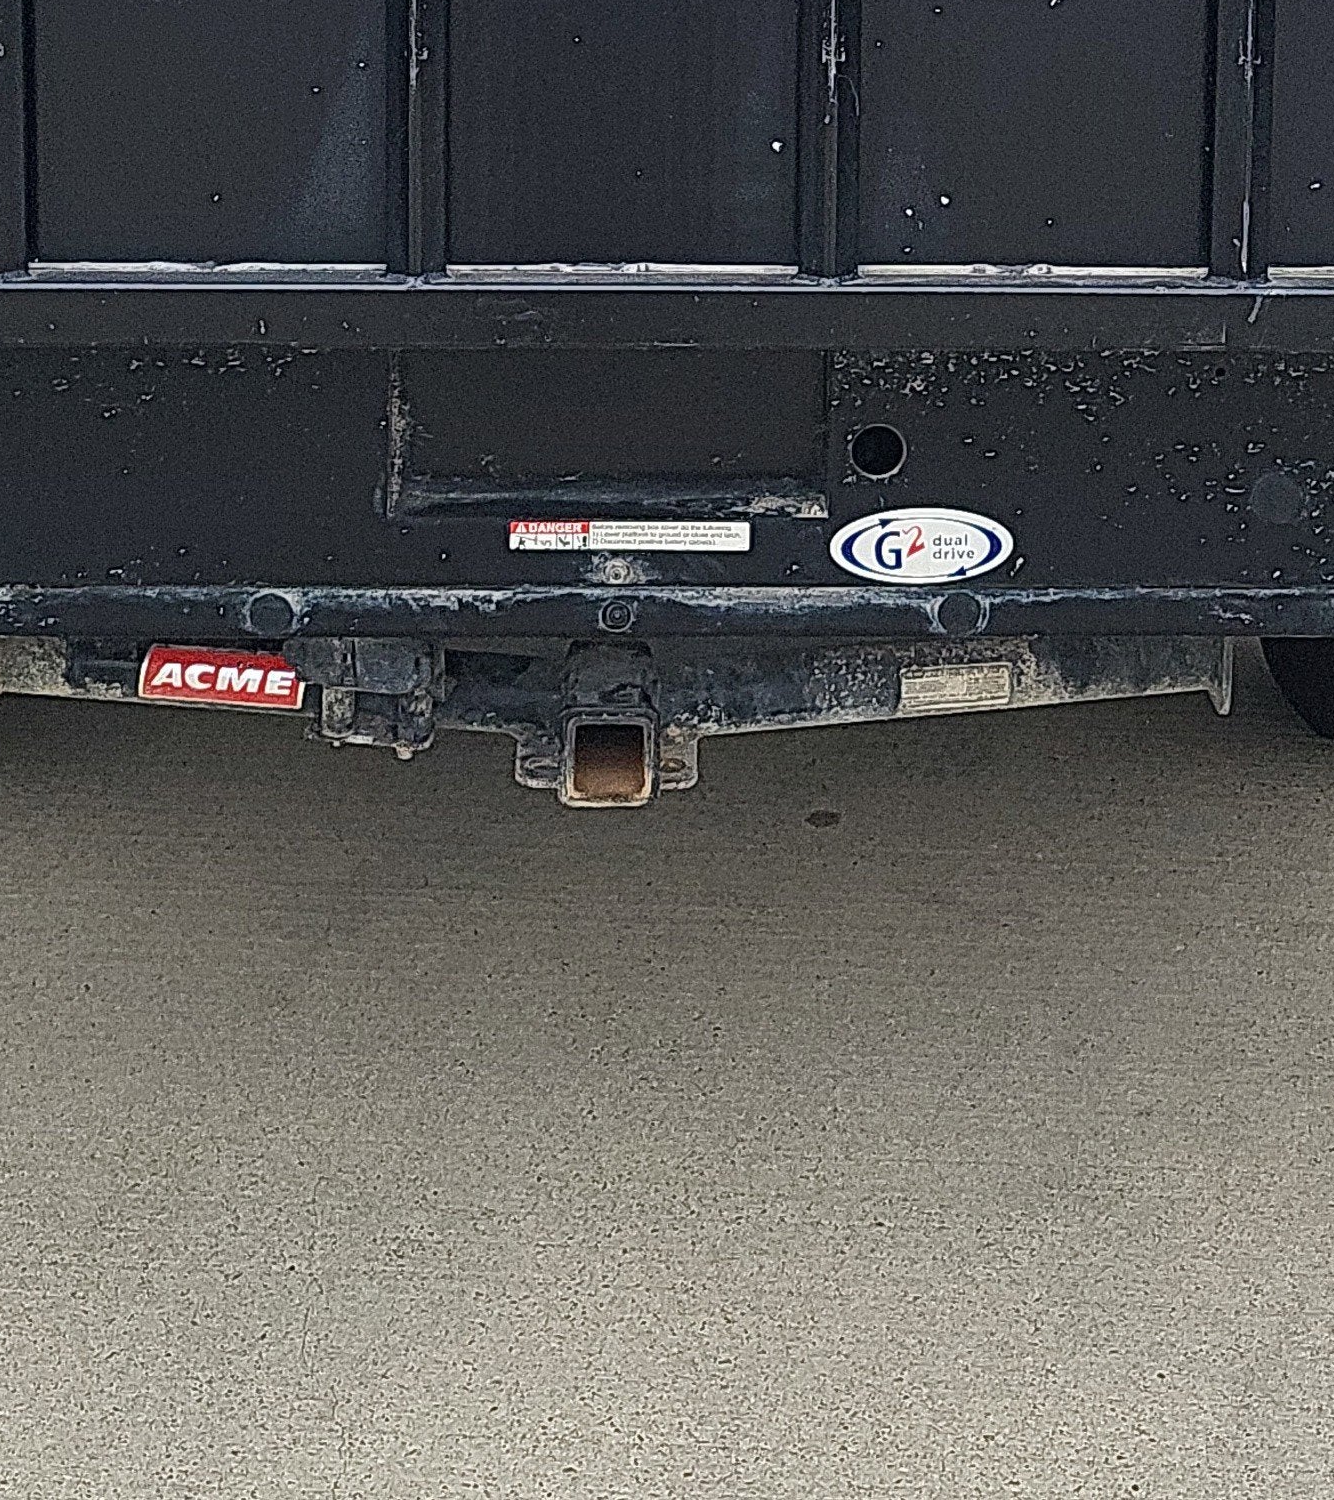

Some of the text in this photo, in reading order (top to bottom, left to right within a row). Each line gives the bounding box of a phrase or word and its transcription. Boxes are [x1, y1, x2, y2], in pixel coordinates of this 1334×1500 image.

[528, 522, 581, 532] DANGER
[932, 534, 967, 546] dual
[932, 548, 975, 560] drive
[151, 662, 295, 695] ACME
